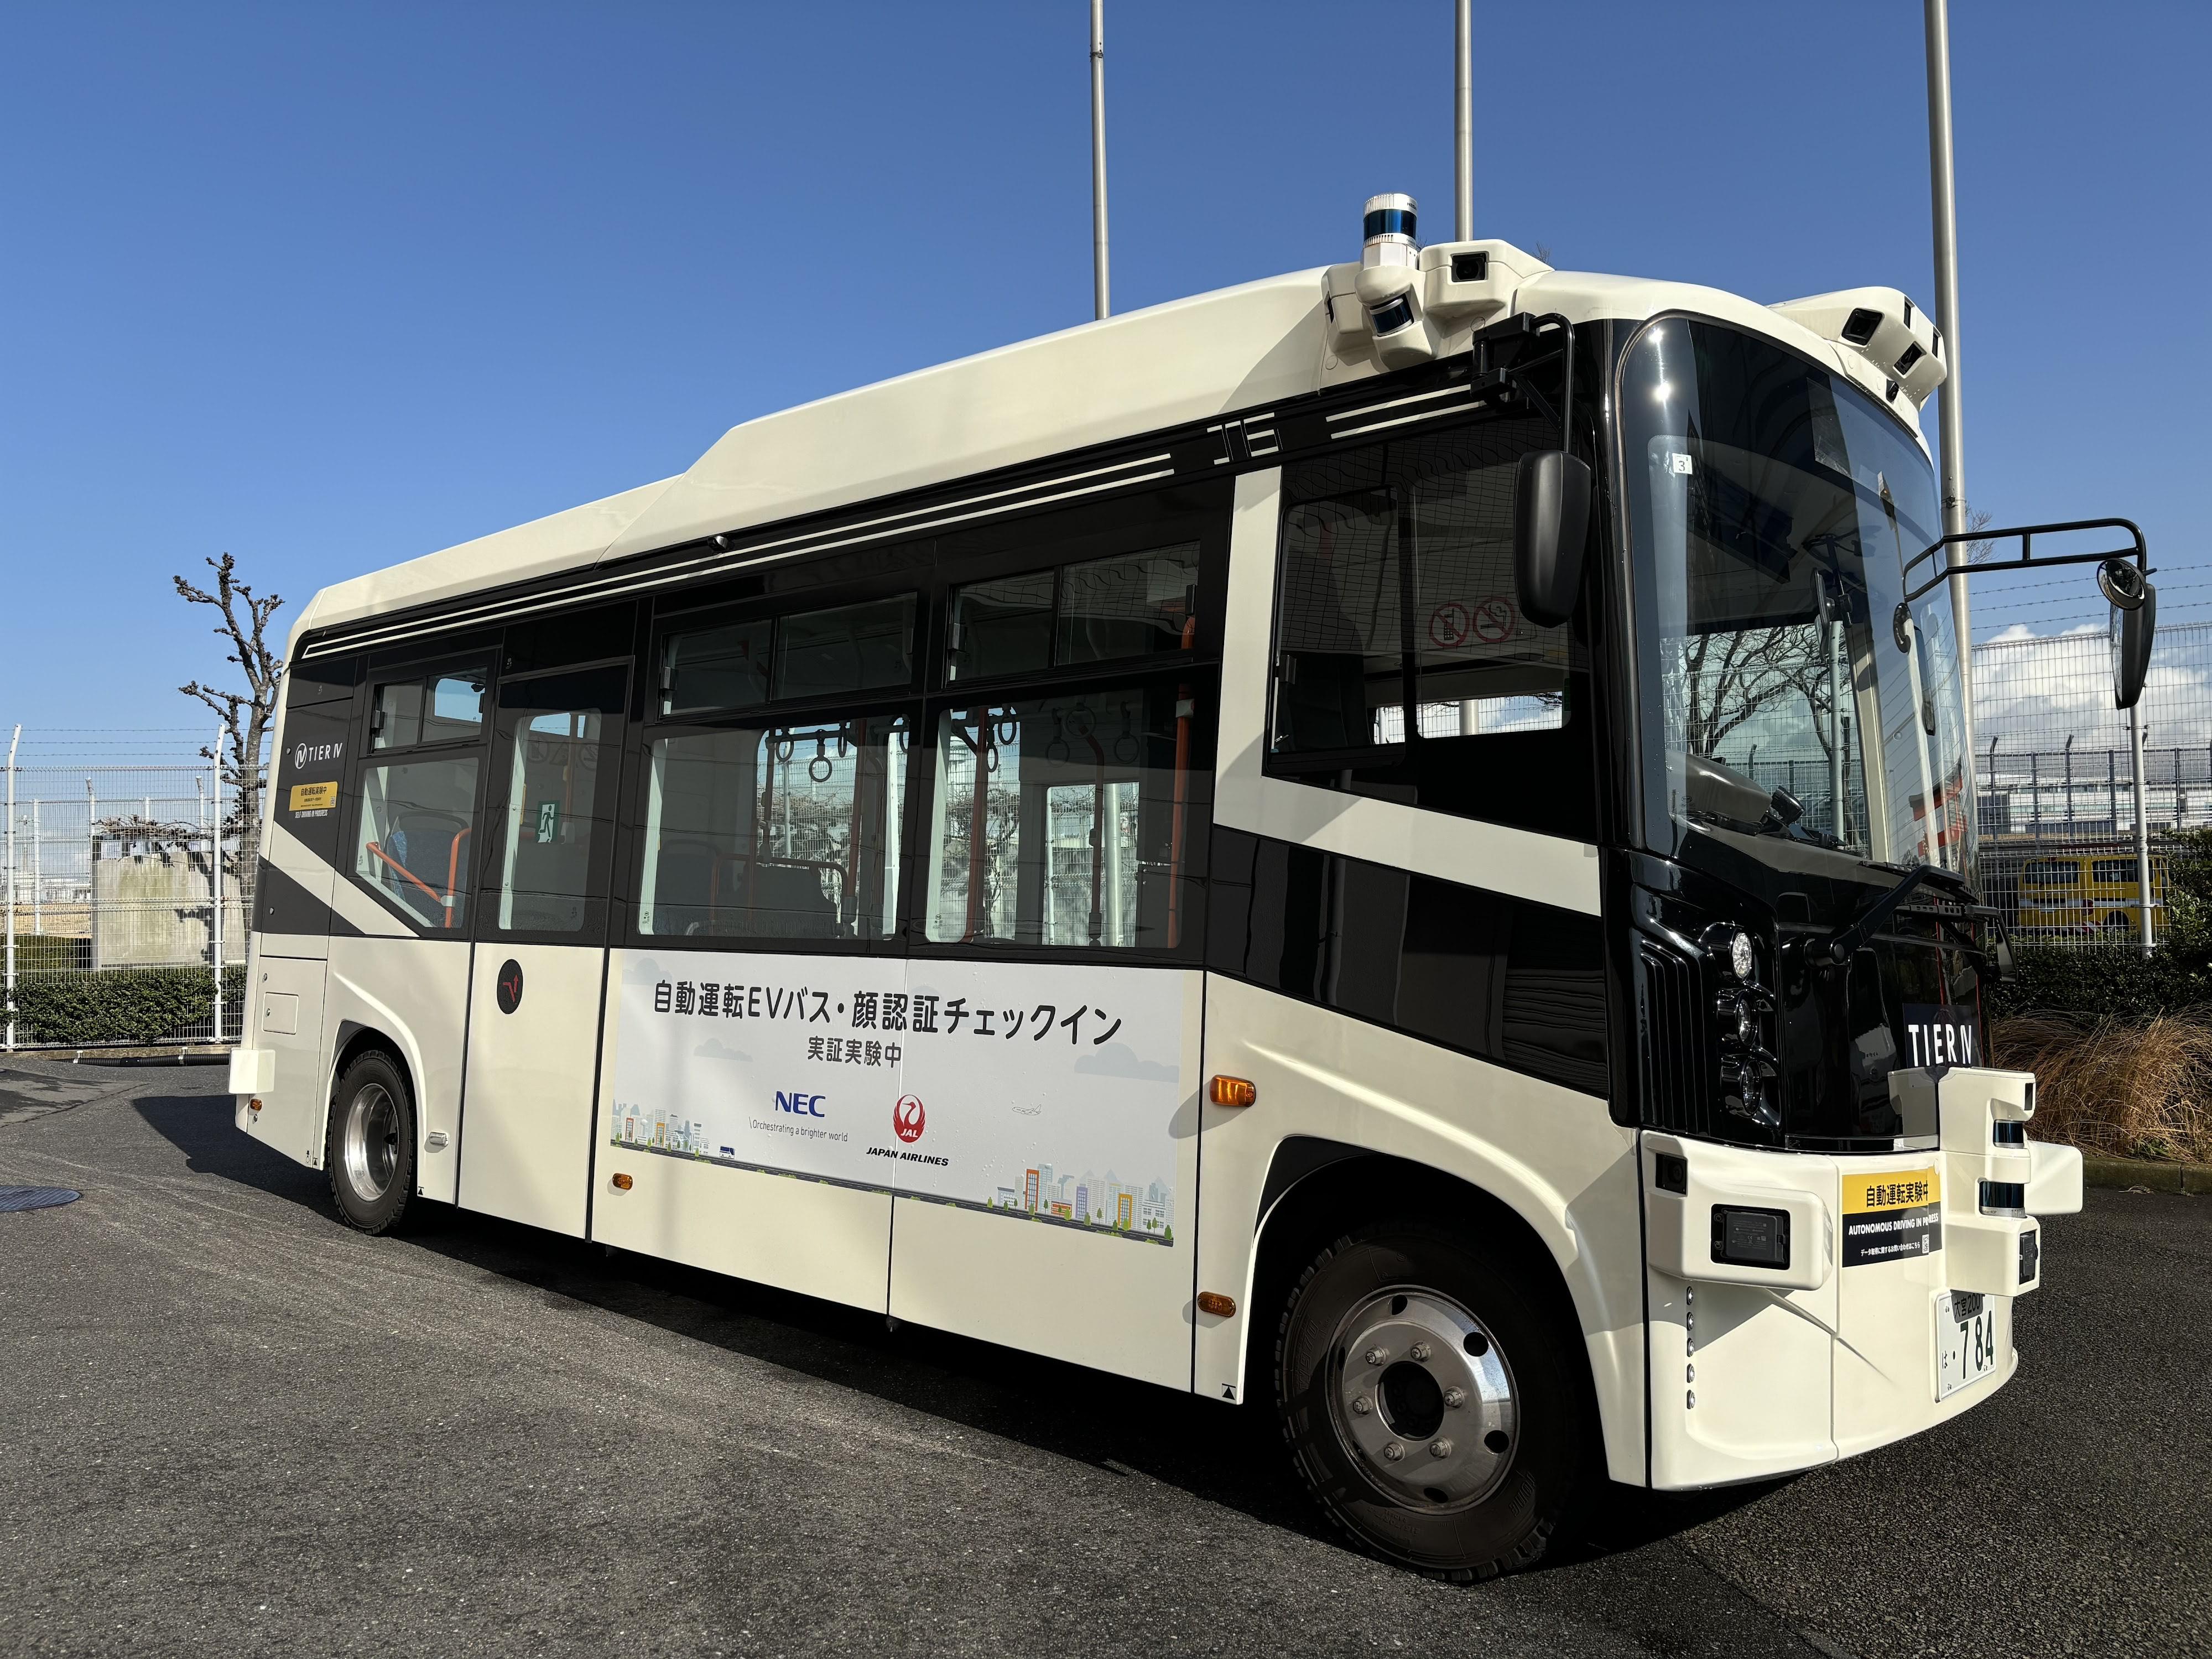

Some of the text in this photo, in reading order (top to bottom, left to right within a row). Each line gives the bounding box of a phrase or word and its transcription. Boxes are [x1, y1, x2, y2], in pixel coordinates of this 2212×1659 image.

[1678, 460, 1685, 471] 3
[309, 745, 331, 762] TIER
[654, 980, 1122, 1045] 自動運転EVバス・顔認証チェックイン
[808, 1036, 902, 1068] 実証実験中
[1908, 1023, 1958, 1067] TIER
[775, 1091, 826, 1117] NEC
[801, 1126, 827, 1140] brighter
[829, 1132, 847, 1142] world
[901, 1128, 919, 1138] JAL
[866, 1147, 949, 1167] JAPAN AIRLINES
[1849, 1213, 1939, 1236] AUTONOMOUS DRIVING IN PRRESS
